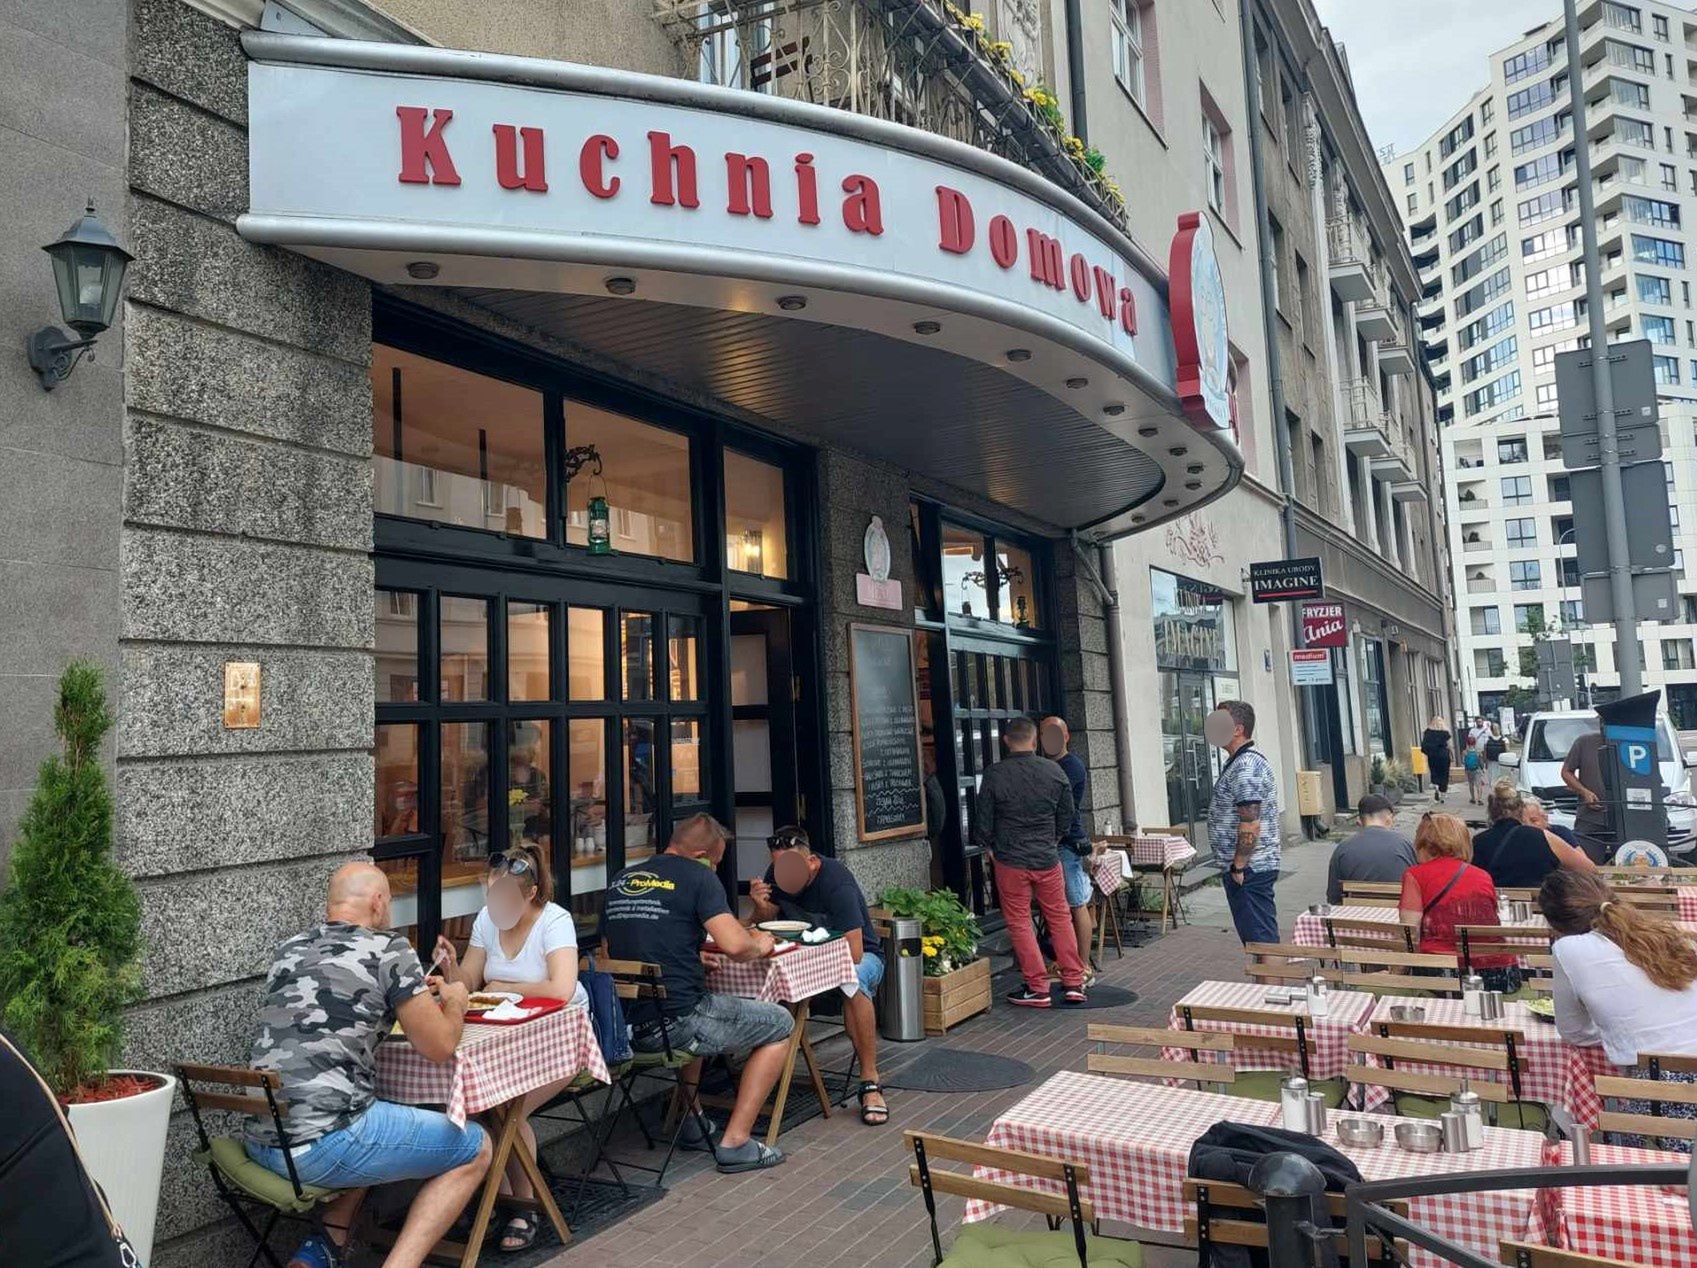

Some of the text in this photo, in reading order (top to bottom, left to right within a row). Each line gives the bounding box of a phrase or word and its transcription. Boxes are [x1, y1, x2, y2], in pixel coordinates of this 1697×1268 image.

[396, 106, 1138, 337] Kuchnia Domowa
[1254, 565, 1316, 577] KLINIKA URODY
[1254, 575, 1319, 591] IMAGINE
[1302, 606, 1342, 618] FRYZJER
[1304, 619, 1344, 644] Ania
[1629, 746, 1647, 769] P
[630, 878, 675, 890] ProMedia
